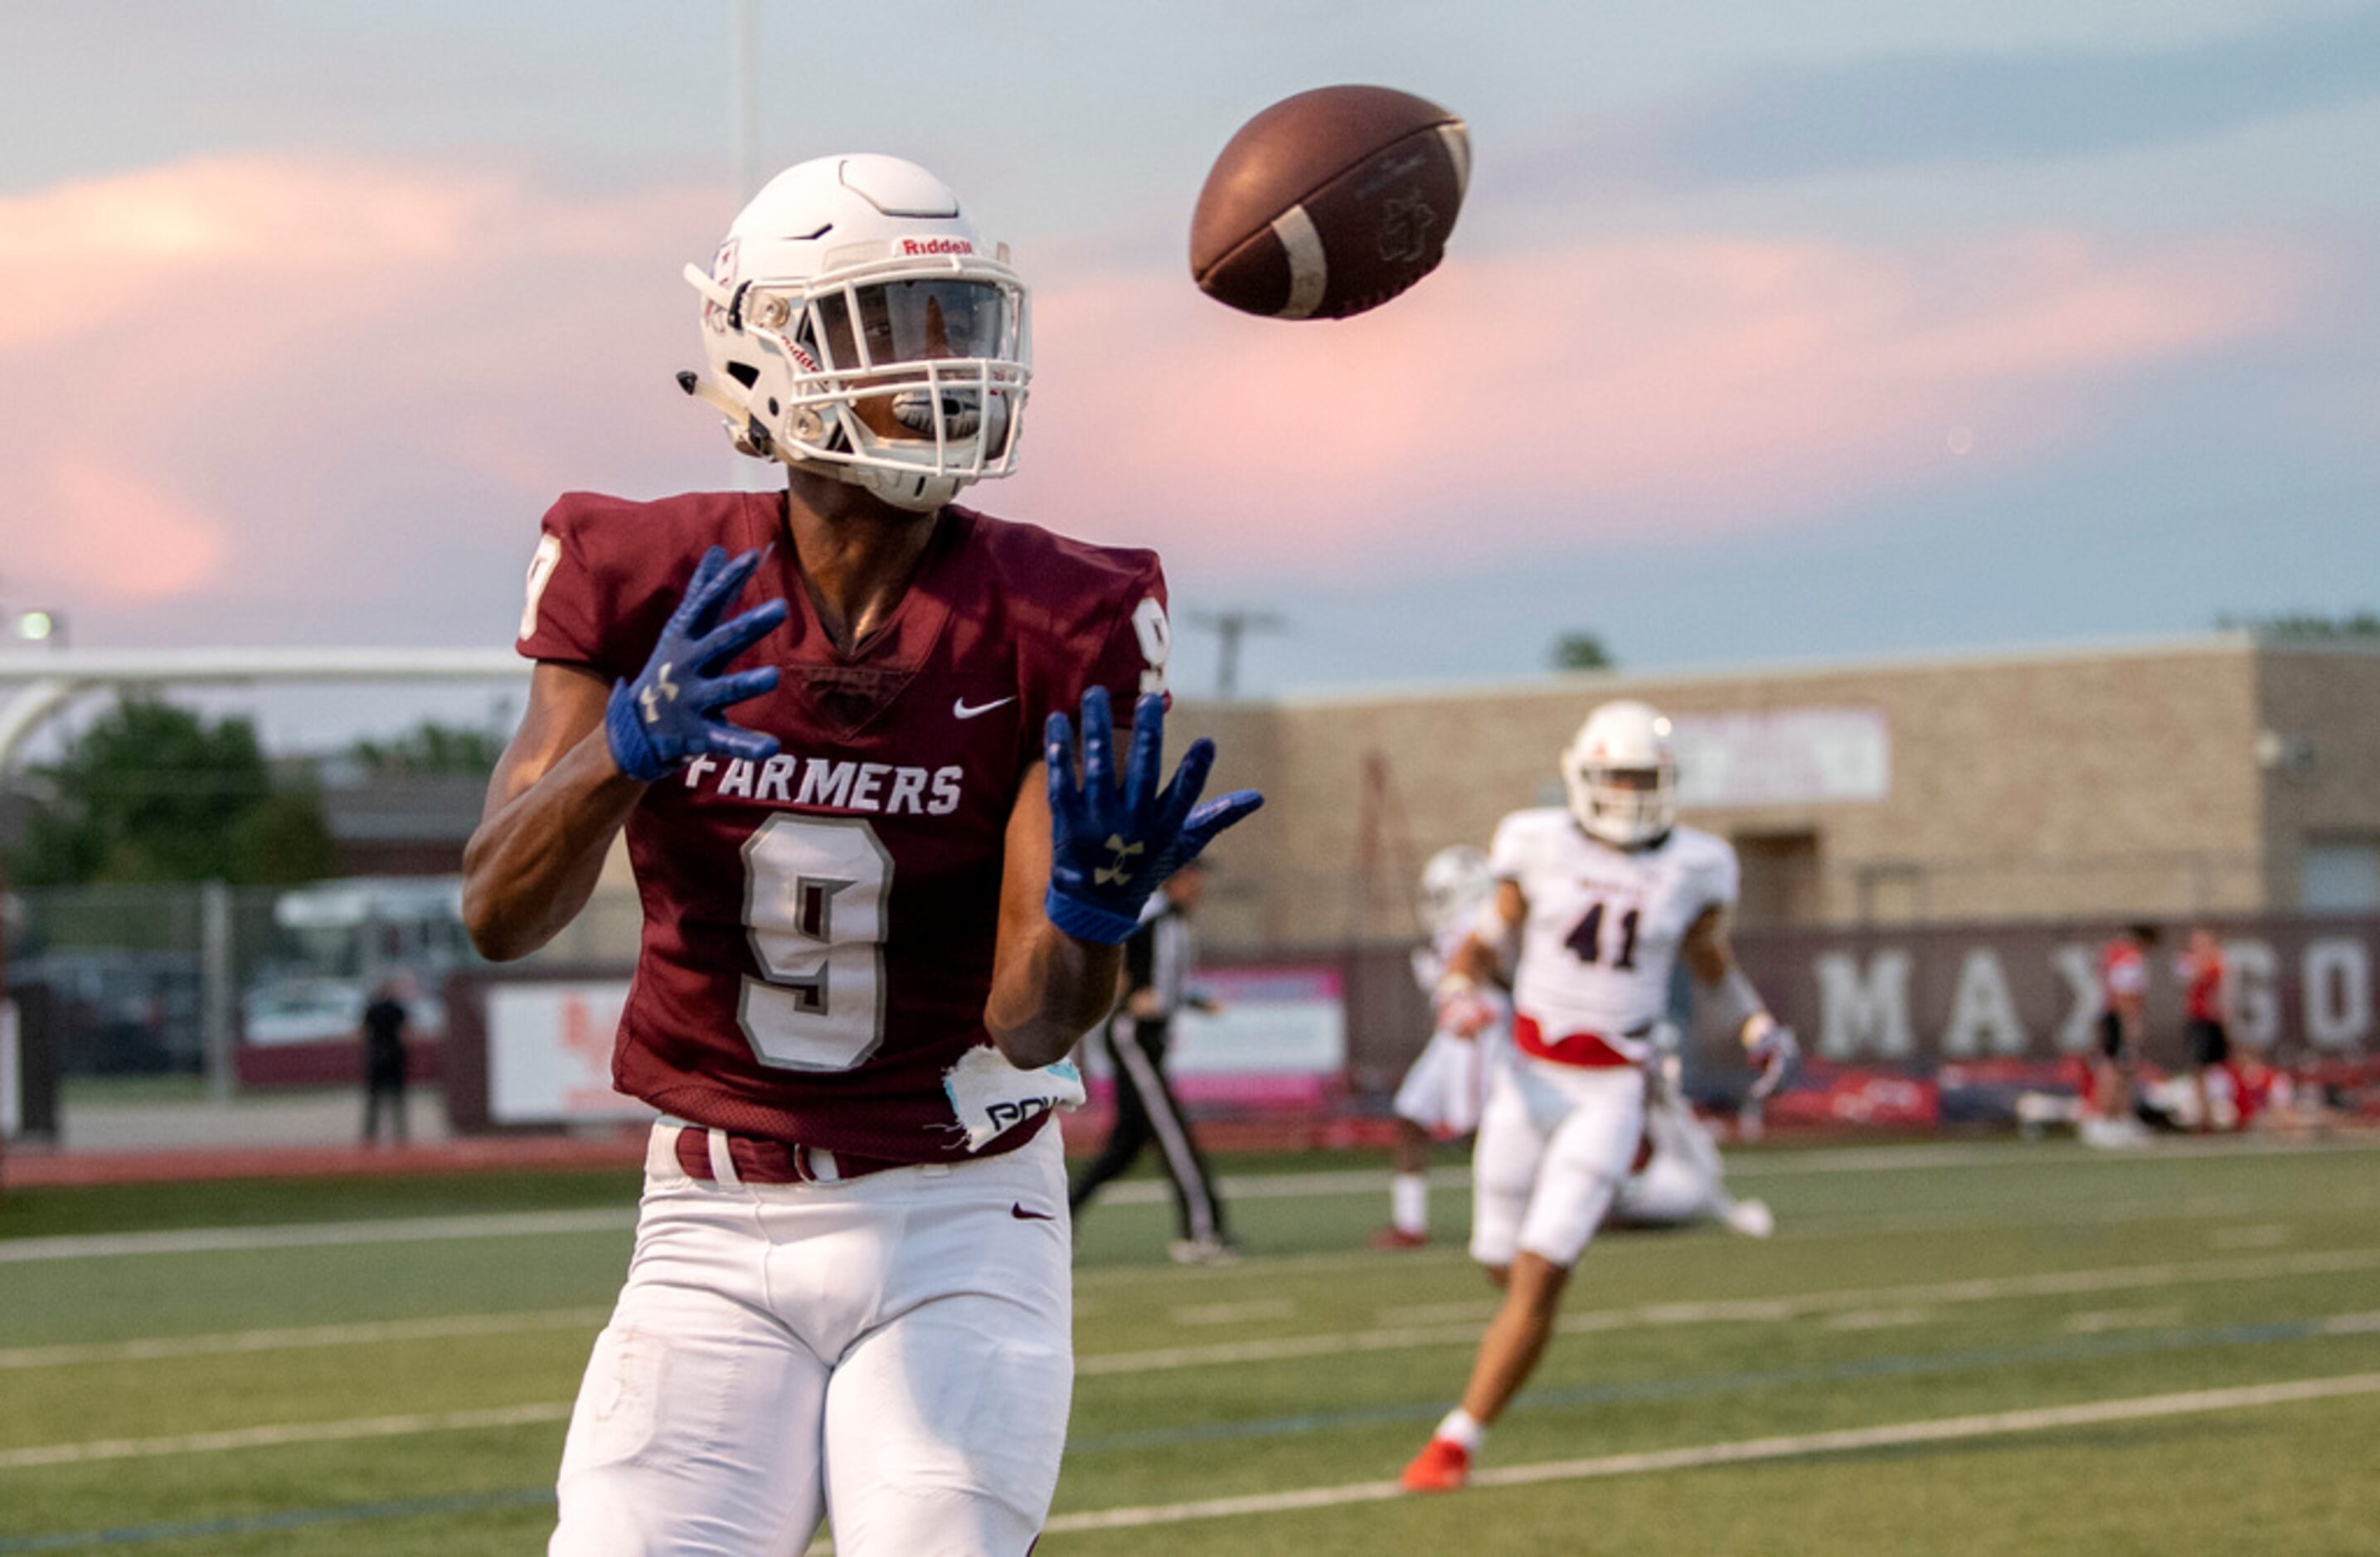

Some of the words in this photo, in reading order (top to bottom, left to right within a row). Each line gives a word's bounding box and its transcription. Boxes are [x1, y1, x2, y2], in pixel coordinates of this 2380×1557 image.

[902, 238, 973, 255] Riddell
[1131, 597, 1170, 696] 9
[685, 751, 964, 815] FARMERS
[736, 812, 896, 1072] 9
[1564, 902, 1641, 969] 41
[1819, 945, 2106, 1060] MAX
